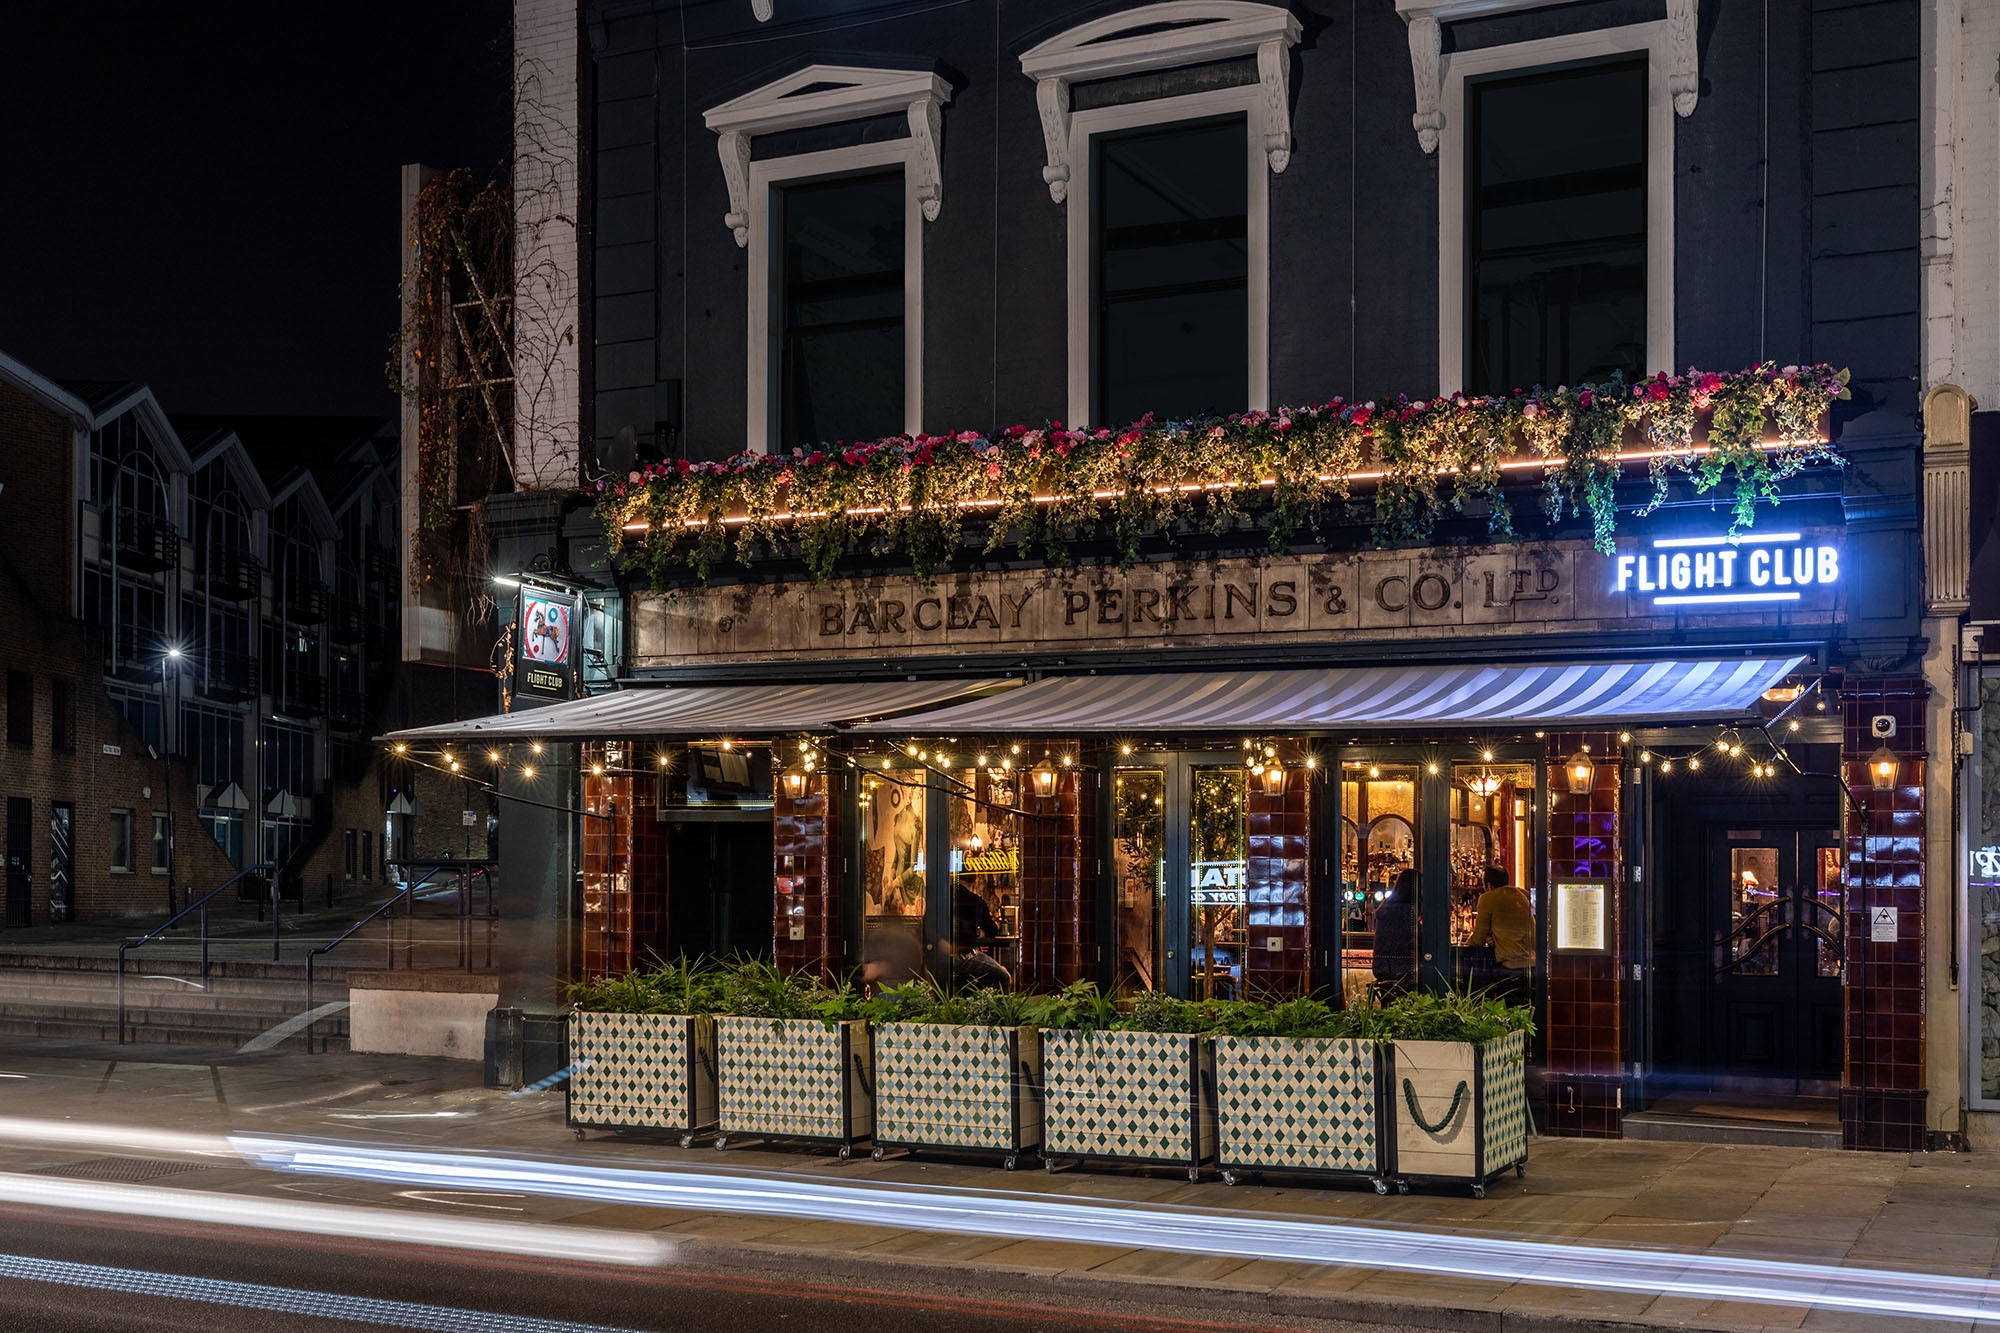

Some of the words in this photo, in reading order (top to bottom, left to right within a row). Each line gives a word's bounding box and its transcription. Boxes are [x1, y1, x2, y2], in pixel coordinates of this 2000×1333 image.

[1617, 550, 1737, 591] FLIGHT
[1750, 546, 1839, 586] CLUB
[819, 593, 1032, 636] BARCLAY
[1062, 580, 1298, 625] PERKINS
[1323, 585, 1350, 615] &
[1374, 572, 1462, 612] CO.
[527, 672, 548, 686] FLIGHT
[548, 675, 563, 688] CLUB
